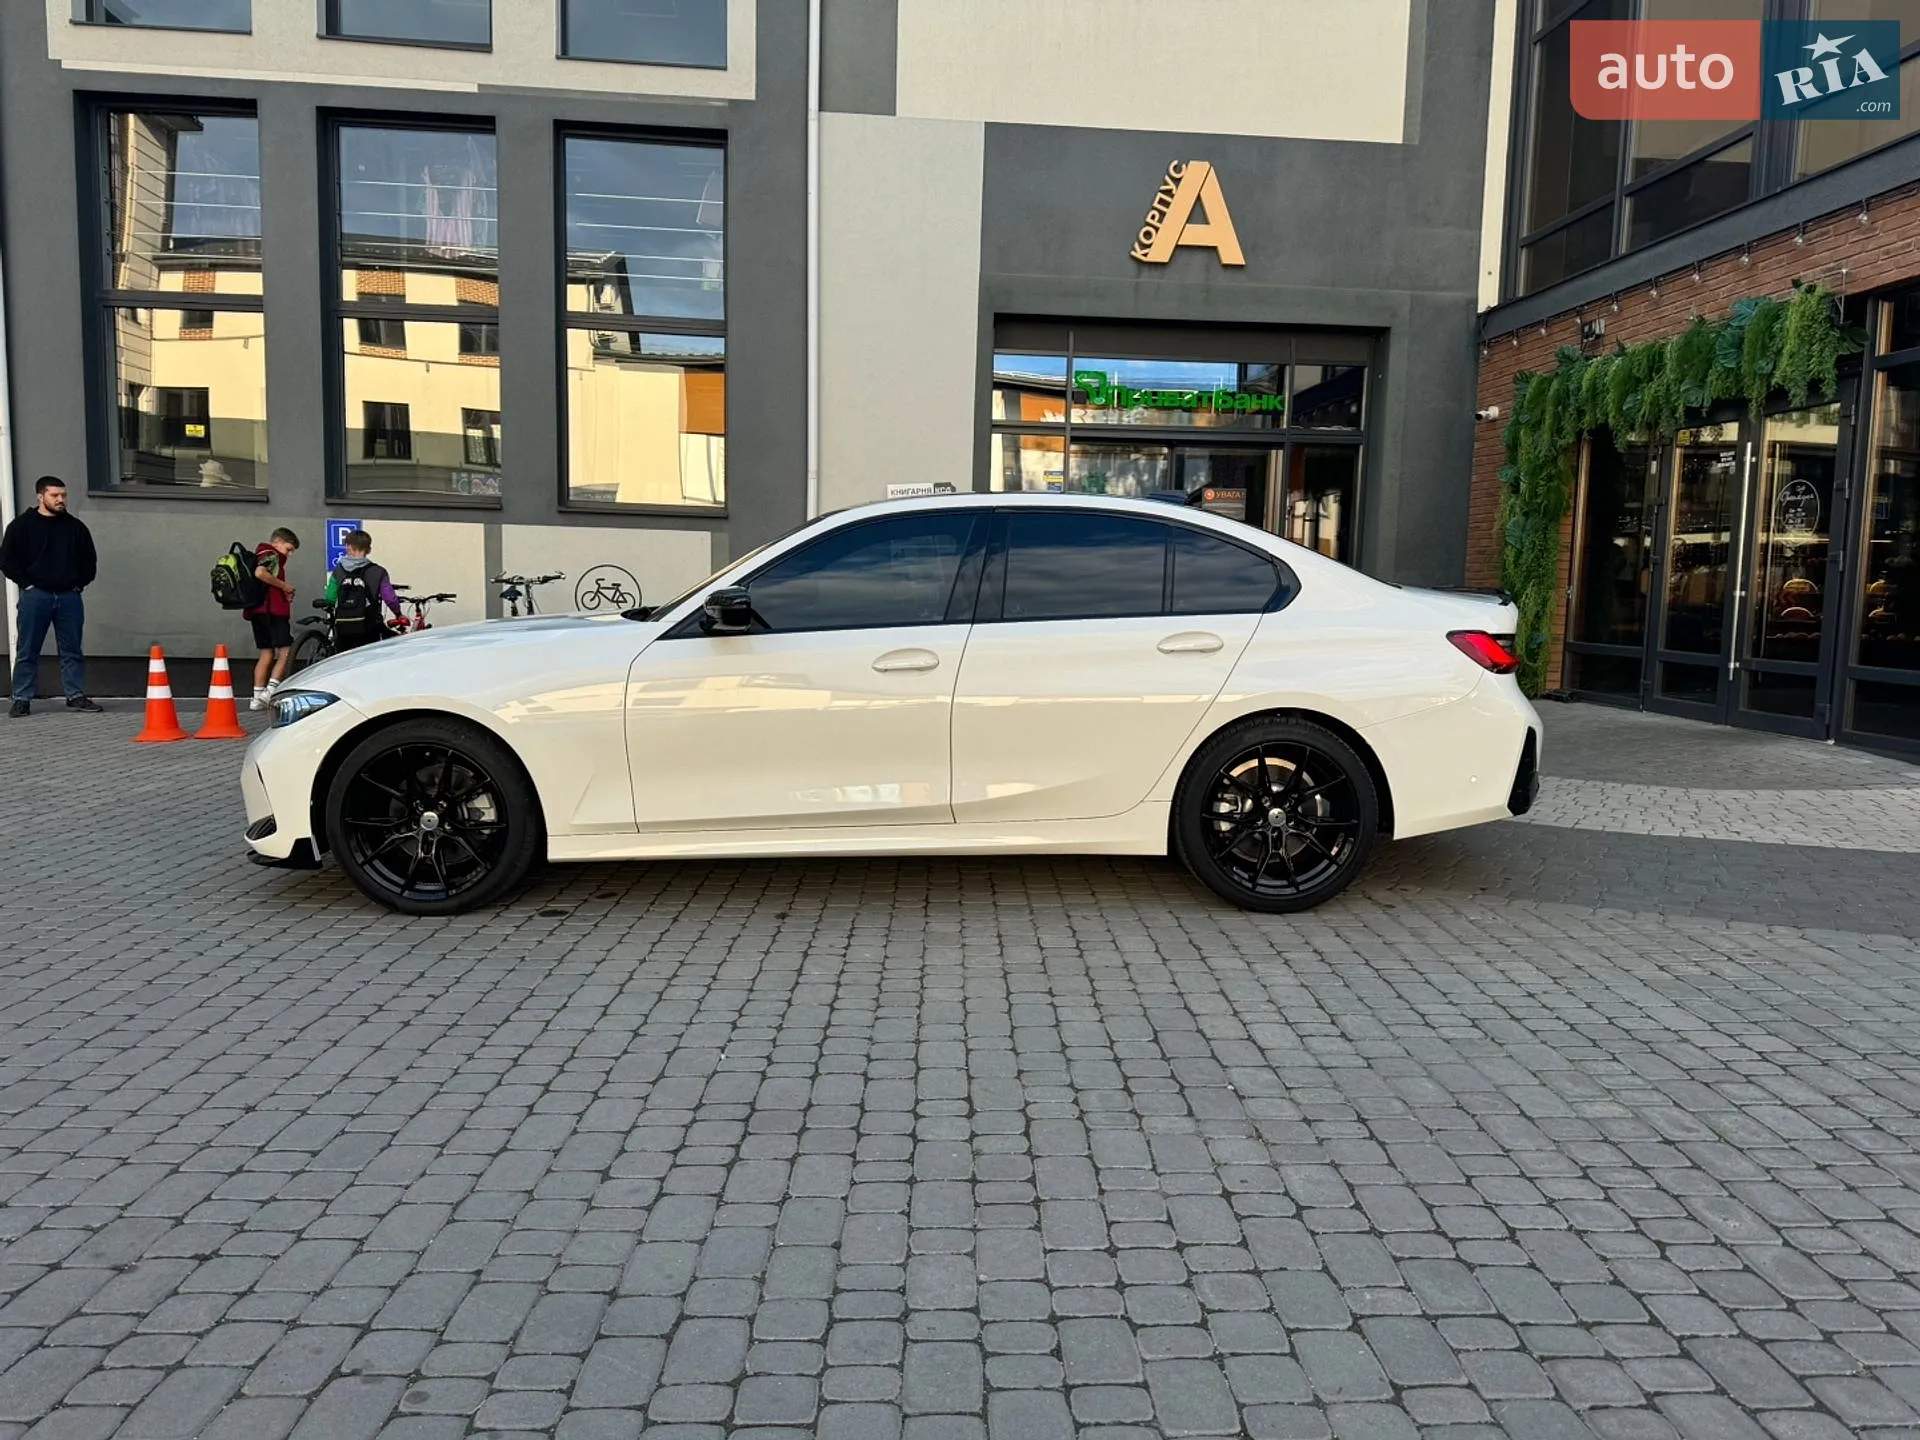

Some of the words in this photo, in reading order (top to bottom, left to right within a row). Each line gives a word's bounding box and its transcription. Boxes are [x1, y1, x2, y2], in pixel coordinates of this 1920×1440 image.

[1130, 159, 1187, 261] КОРПУС
[1146, 160, 1246, 266] А
[338, 527, 352, 546] P
